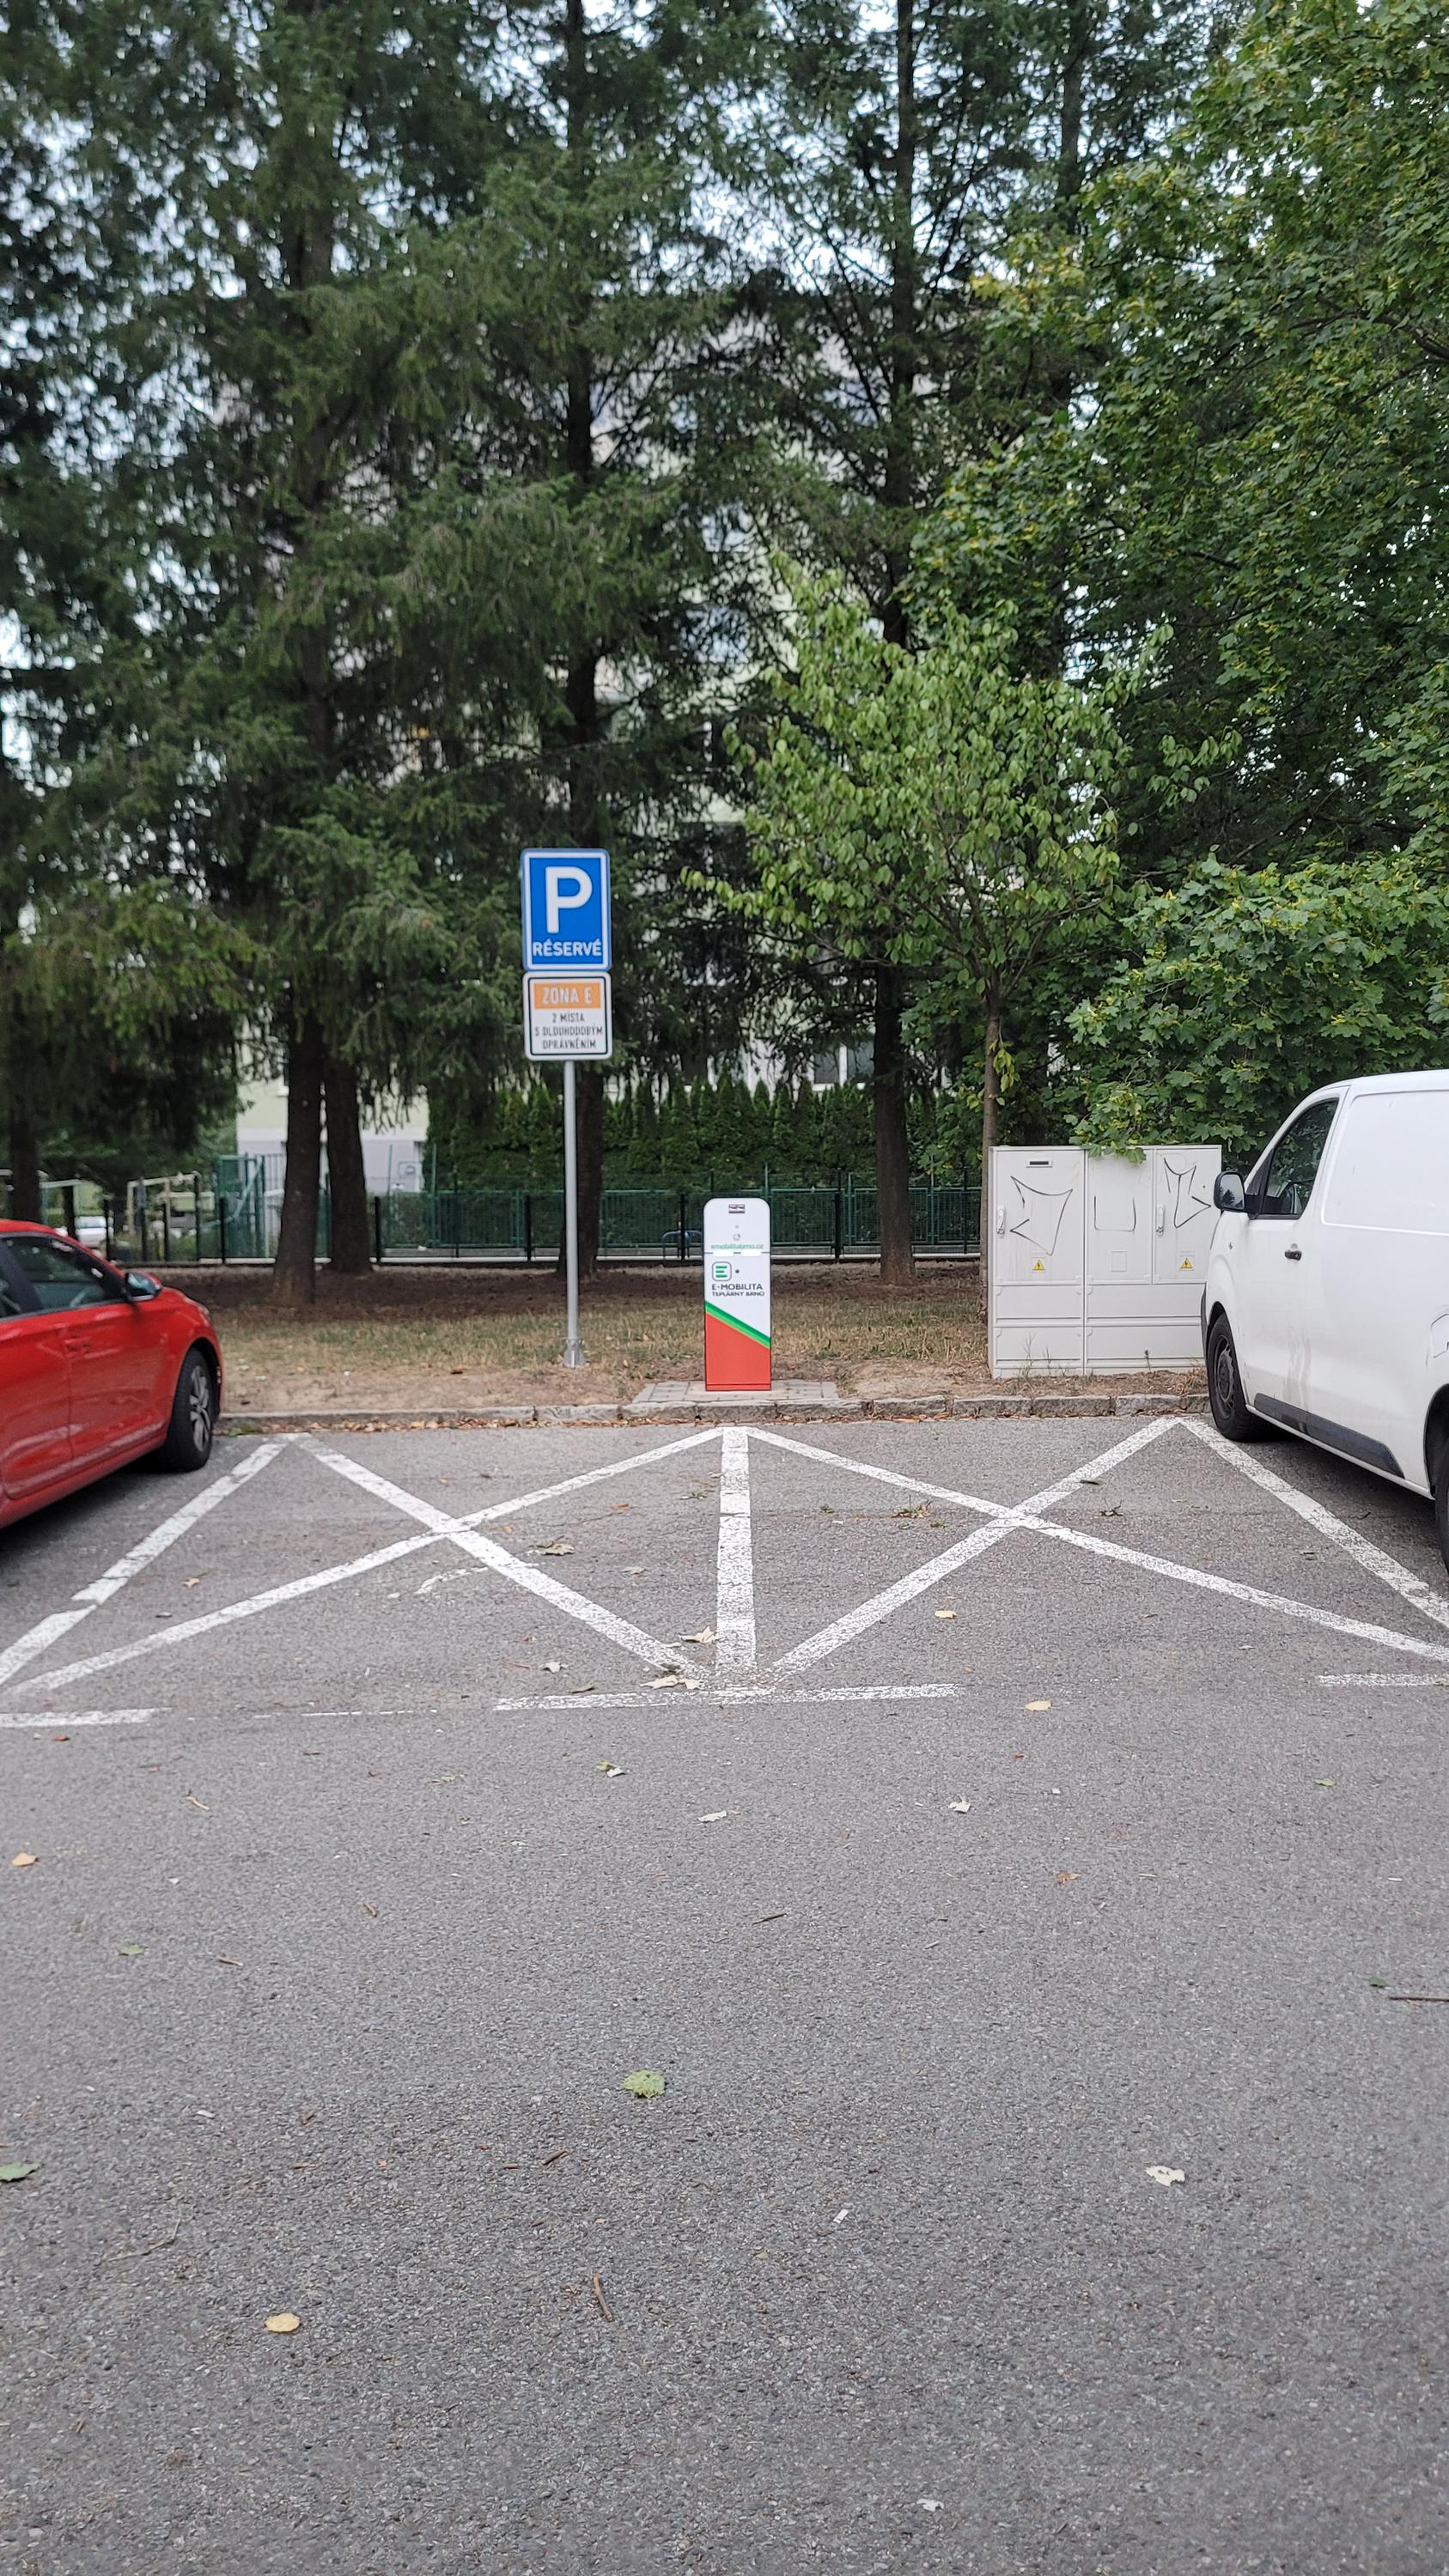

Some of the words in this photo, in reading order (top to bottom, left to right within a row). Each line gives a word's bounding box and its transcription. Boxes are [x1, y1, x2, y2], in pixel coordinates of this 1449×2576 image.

[545, 866, 593, 933] P
[533, 938, 602, 957] RÉSERVÉ
[584, 987, 592, 1004] E
[552, 1013, 557, 1023] 2
[535, 1027, 539, 1036] S
